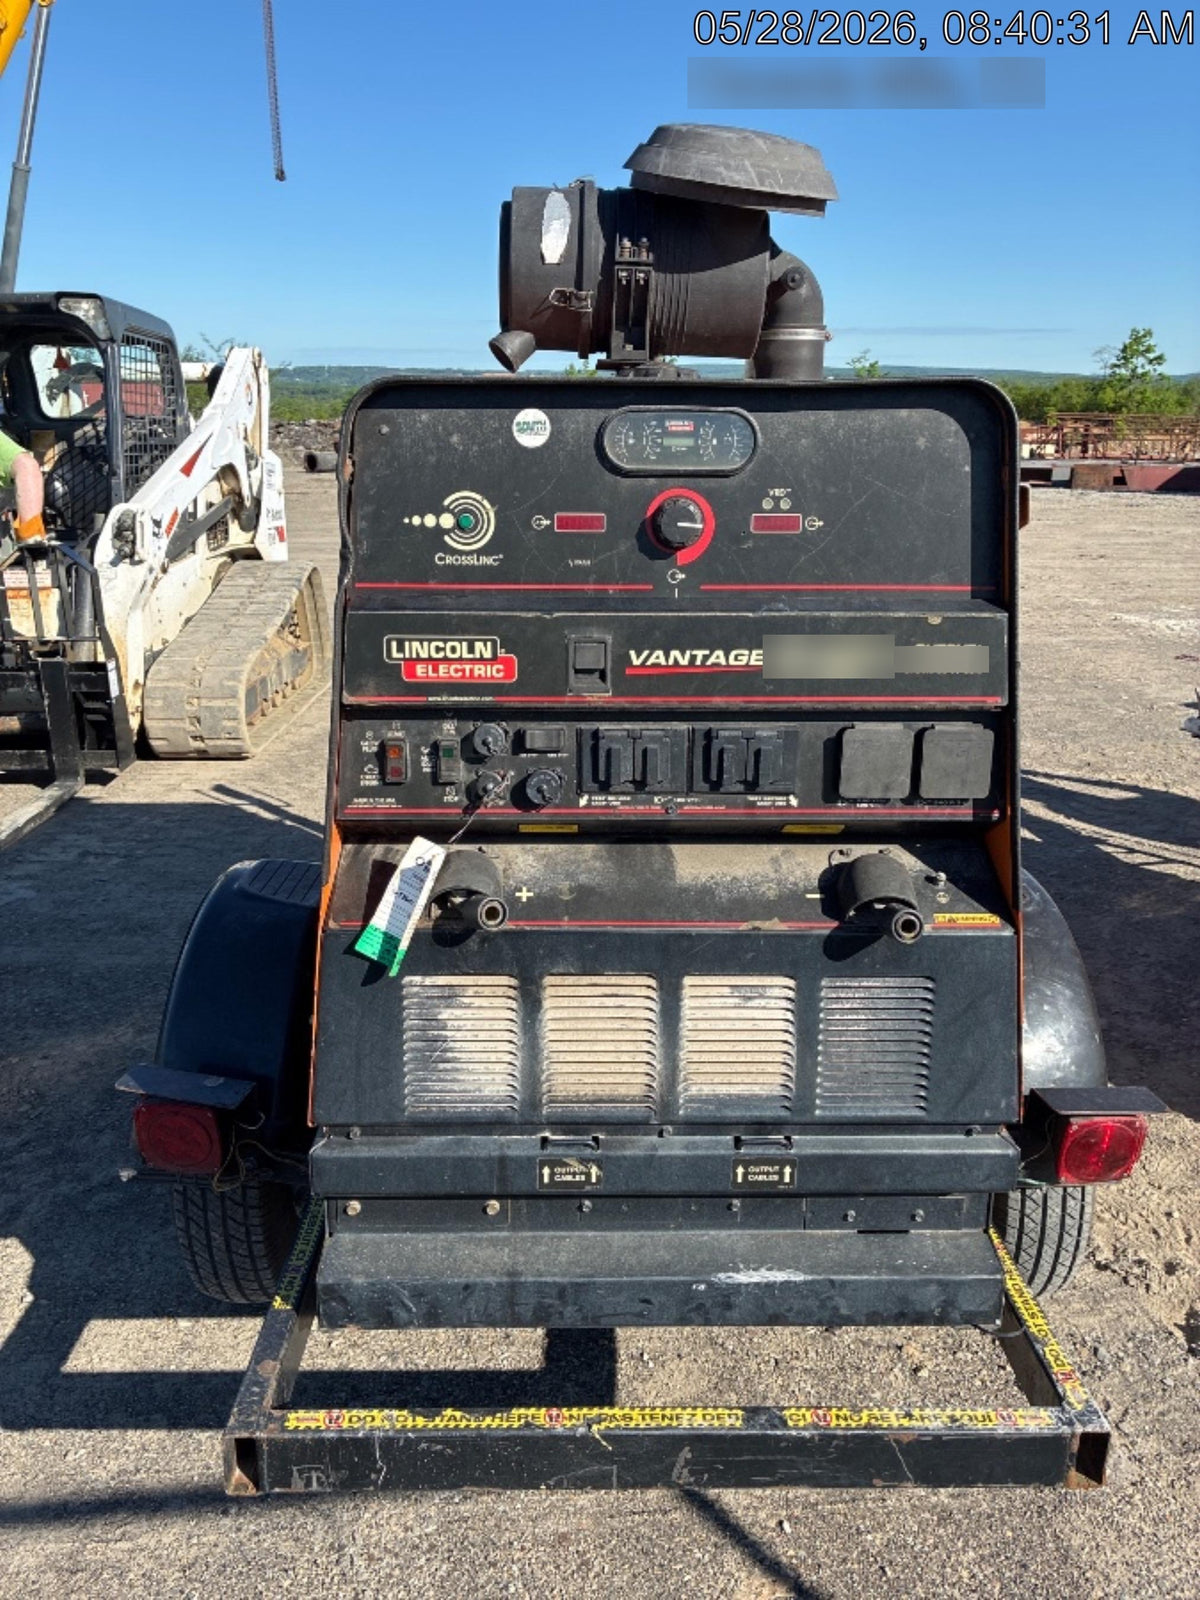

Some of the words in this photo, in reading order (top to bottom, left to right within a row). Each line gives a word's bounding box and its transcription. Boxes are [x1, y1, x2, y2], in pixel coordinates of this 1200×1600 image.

[390, 640, 492, 659] LINCOLN
[628, 649, 763, 666] VANTAGE
[415, 664, 505, 678] ELECTRIC
[748, 1165, 780, 1173] OUTPUT
[1012, 1281, 1039, 1321] STAND
[347, 1414, 376, 1424] DO
[492, 1413, 541, 1423] HERE
[835, 1412, 863, 1423] NO
